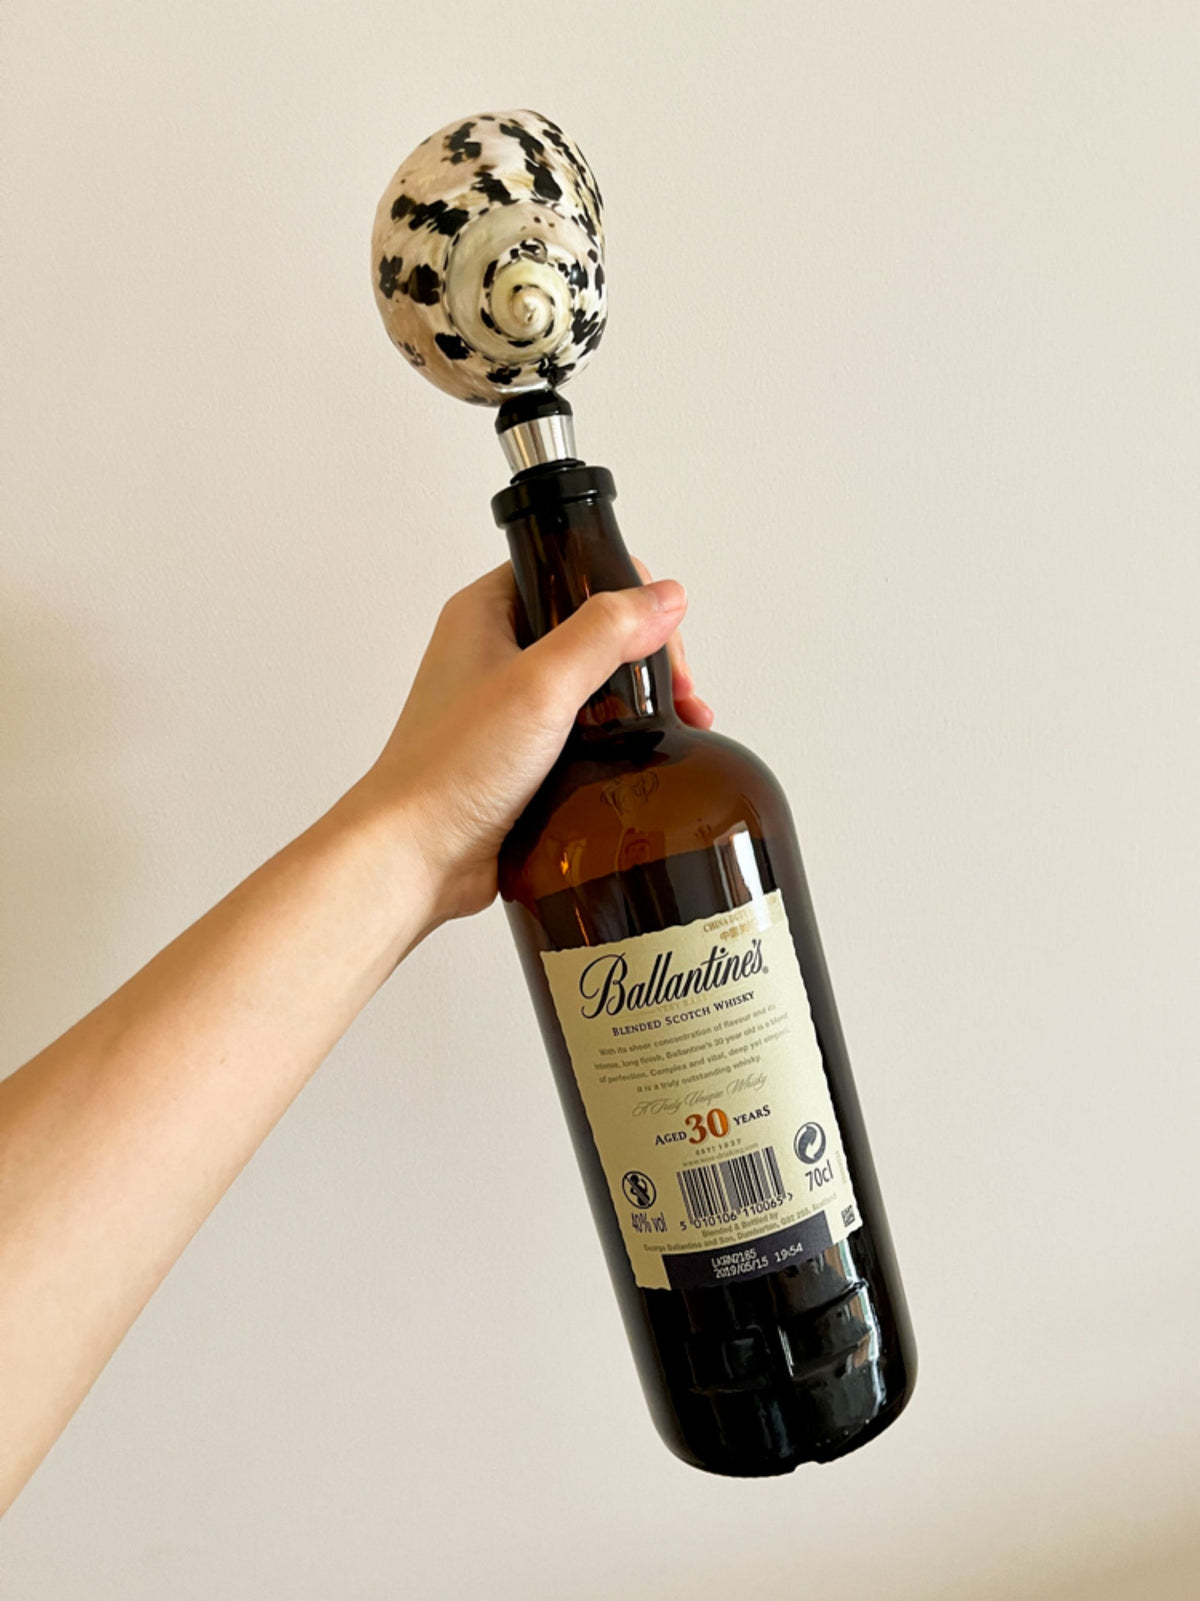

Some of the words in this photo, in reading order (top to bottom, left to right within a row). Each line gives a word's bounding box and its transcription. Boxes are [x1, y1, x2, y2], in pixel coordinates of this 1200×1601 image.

[579, 938, 763, 1020] Ballantine's
[611, 1019, 662, 1037] BLENDED
[664, 1006, 711, 1026] SCOTCH
[713, 990, 755, 1012] WHISKY
[629, 1042, 651, 1052] sheer
[653, 1026, 713, 1048] concentration
[713, 1022, 723, 1032] of
[723, 1013, 751, 1029] flavour
[622, 1059, 640, 1068] long
[725, 1031, 743, 1045] year
[743, 1026, 757, 1037] old
[649, 1063, 688, 1077] Complex
[688, 1057, 706, 1069] and
[727, 1045, 750, 1057] deep
[653, 1082, 660, 1090] a
[659, 1077, 681, 1090] truly
[680, 1064, 733, 1085] outstanding
[654, 1129, 688, 1147] AGED
[683, 1107, 731, 1146] 30
[732, 1104, 772, 1128] YEARS
[804, 1158, 835, 1193] 70cl
[679, 1220, 689, 1232] 5
[693, 1211, 738, 1230] 010106
[742, 1195, 785, 1218] 110065
[713, 1255, 770, 1279] 2019/05/15
